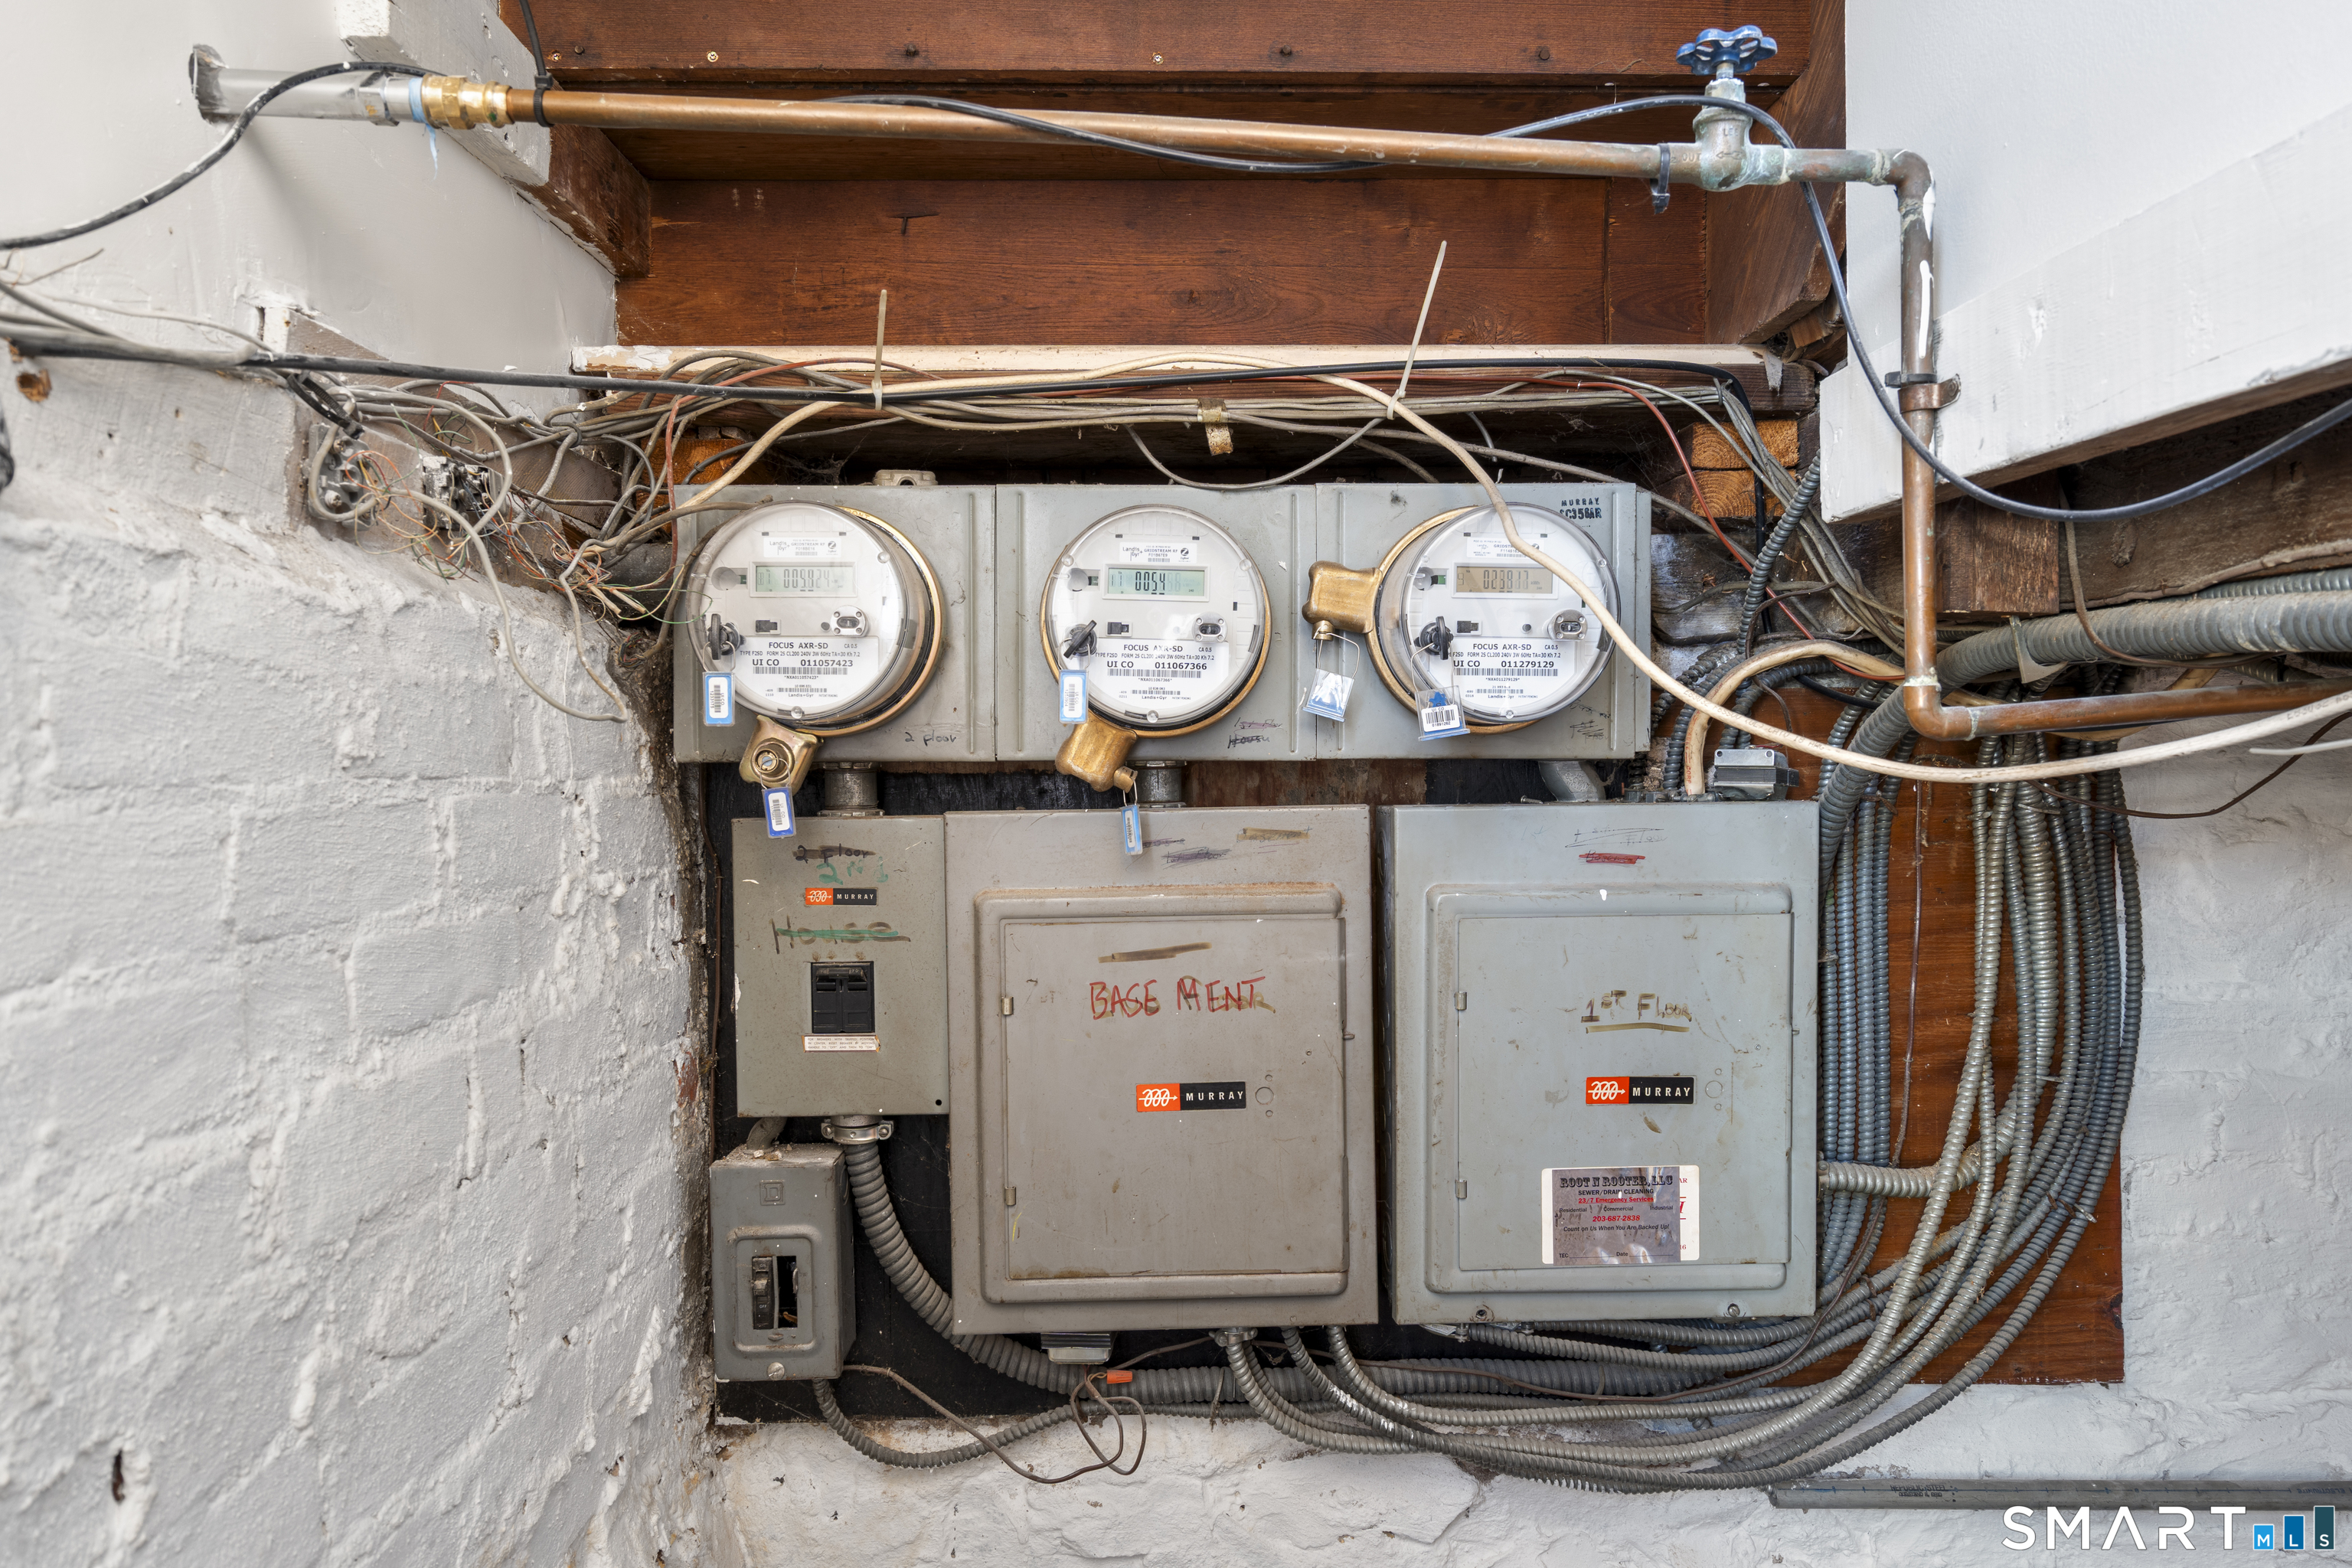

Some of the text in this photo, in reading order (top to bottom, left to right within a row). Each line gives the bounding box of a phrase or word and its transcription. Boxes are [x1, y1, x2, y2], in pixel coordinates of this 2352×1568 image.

[1561, 497, 1599, 506] MURRAY
[905, 732, 914, 742] 2
[1186, 1091, 1243, 1101] MURRAY
[1633, 1087, 1690, 1096] MURRAY
[1560, 1175, 1673, 1188] ROOT N ROOTER, LLC
